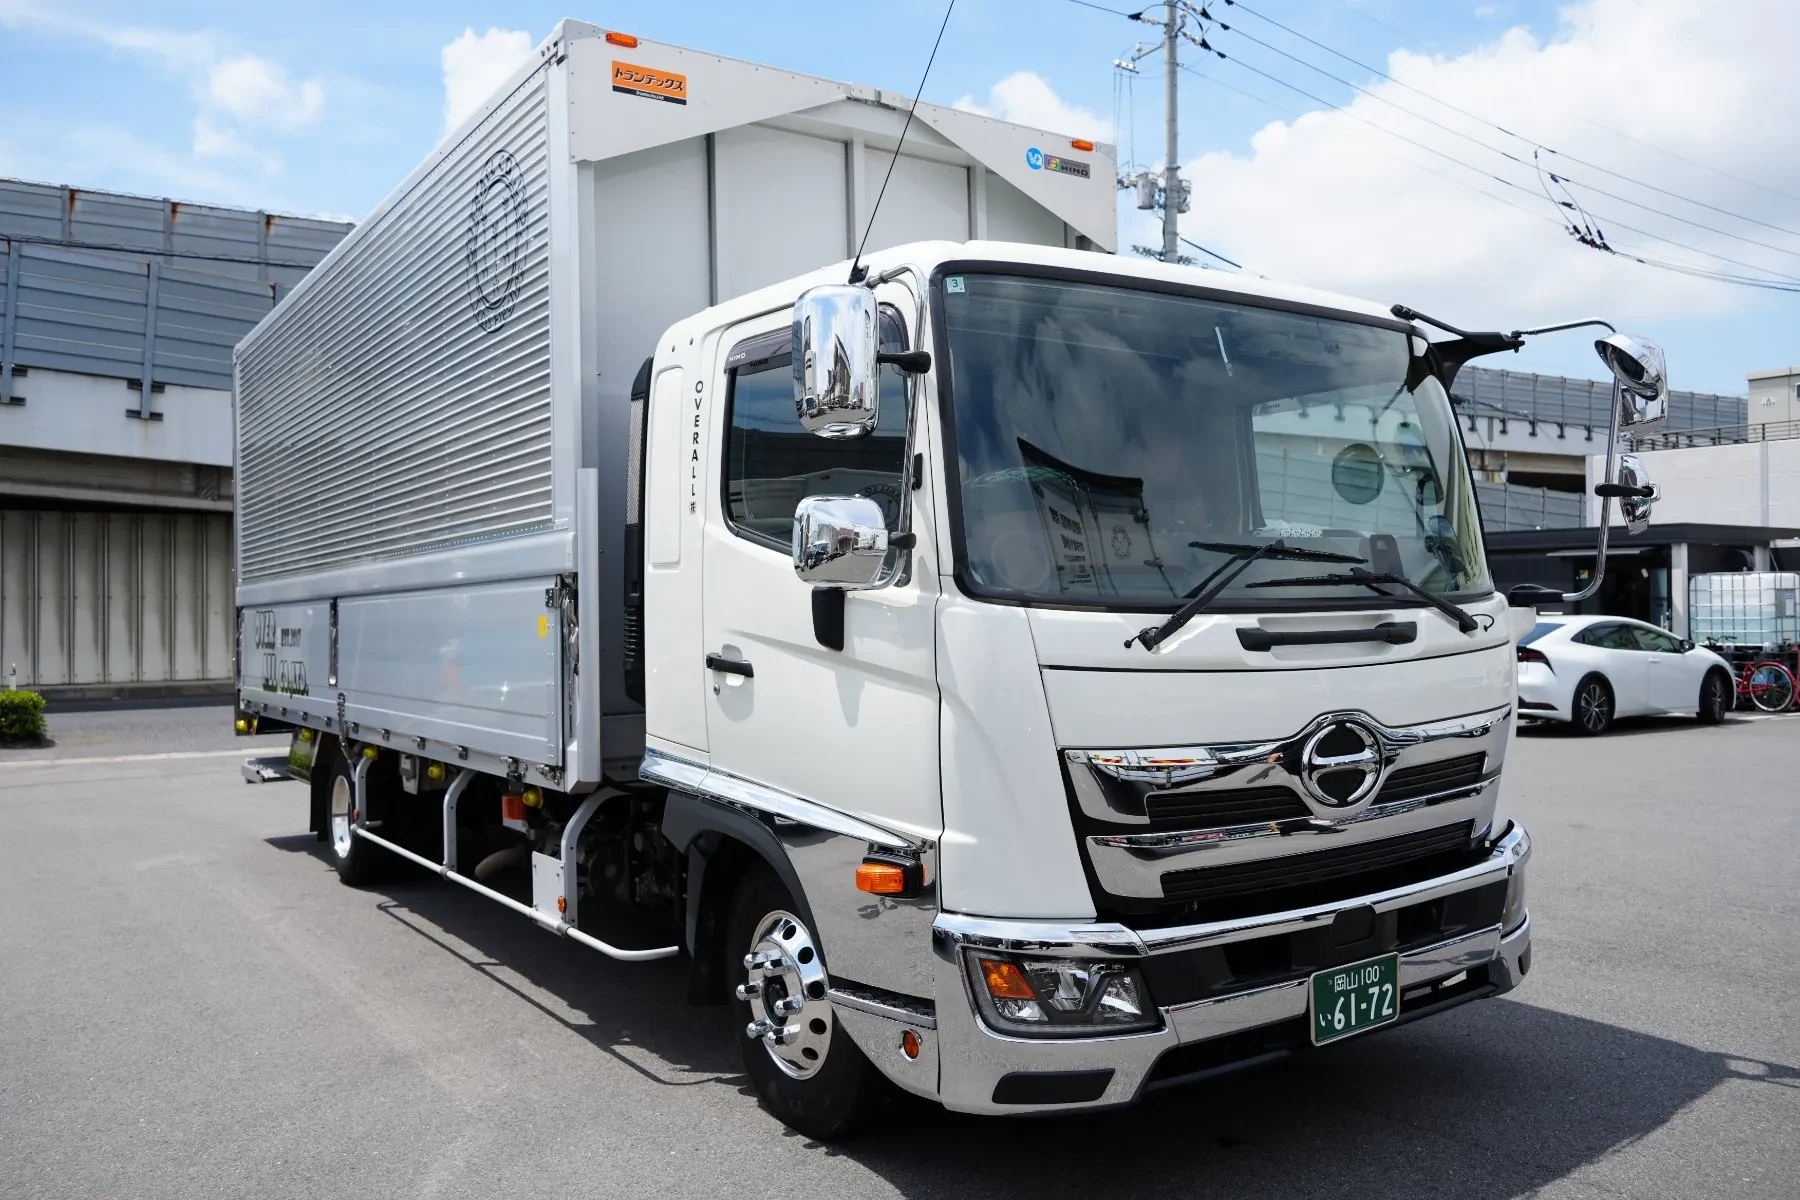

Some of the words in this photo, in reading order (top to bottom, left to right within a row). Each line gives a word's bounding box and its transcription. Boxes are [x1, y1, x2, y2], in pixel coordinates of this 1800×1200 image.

[615, 67, 684, 92] トランテックス
[1061, 165, 1088, 177] HINO
[951, 278, 959, 288] 3
[729, 352, 746, 362] HINO
[691, 380, 704, 497] OVERALL
[1334, 972, 1358, 993] 岡山
[1361, 965, 1380, 986] 100
[1319, 1012, 1332, 1027] い
[1333, 982, 1393, 1030] 61-72
